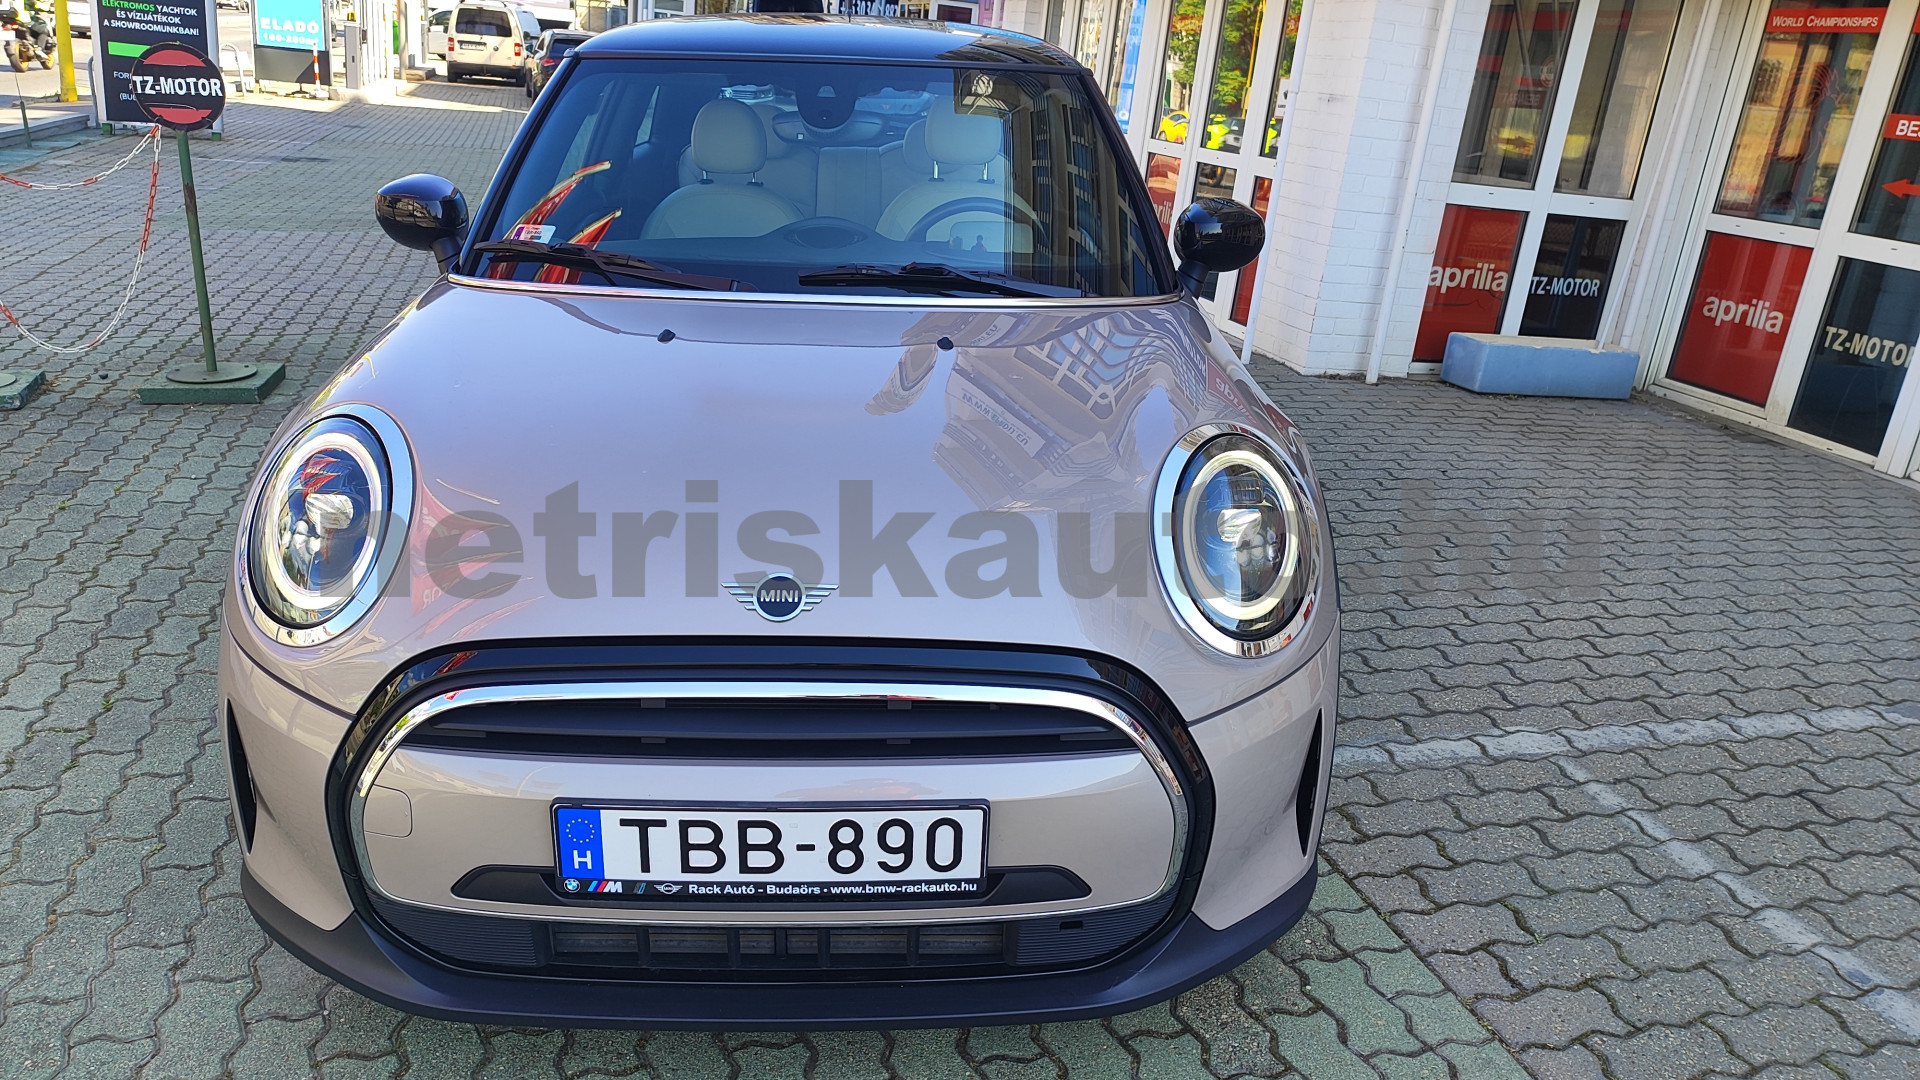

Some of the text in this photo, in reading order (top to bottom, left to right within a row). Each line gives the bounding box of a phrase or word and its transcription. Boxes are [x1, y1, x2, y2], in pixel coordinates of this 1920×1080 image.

[102, 0, 197, 16] ELEKTROMOS YACHTOK
[116, 9, 126, 18] ÉS
[103, 19, 199, 36] A SHOWROOMUNKBAN!
[260, 16, 319, 34] ELADÓ
[1772, 15, 1879, 27] WORLD CHAMPIONSHIPS
[132, 75, 223, 97] TZ-MOTOR
[1895, 119, 1920, 138] BE
[1428, 262, 1509, 294] aprilia
[1530, 276, 1600, 297] TZ-MOTOR
[1702, 296, 1784, 334] aprilia
[760, 589, 799, 603] MINI
[619, 816, 964, 877] TBB-890
[573, 850, 592, 870] H
[689, 884, 722, 895] Rack
[724, 883, 755, 895] Autó
[766, 884, 820, 895] Budaörs
[830, 882, 977, 895] www.bmw-rackauto.hu
